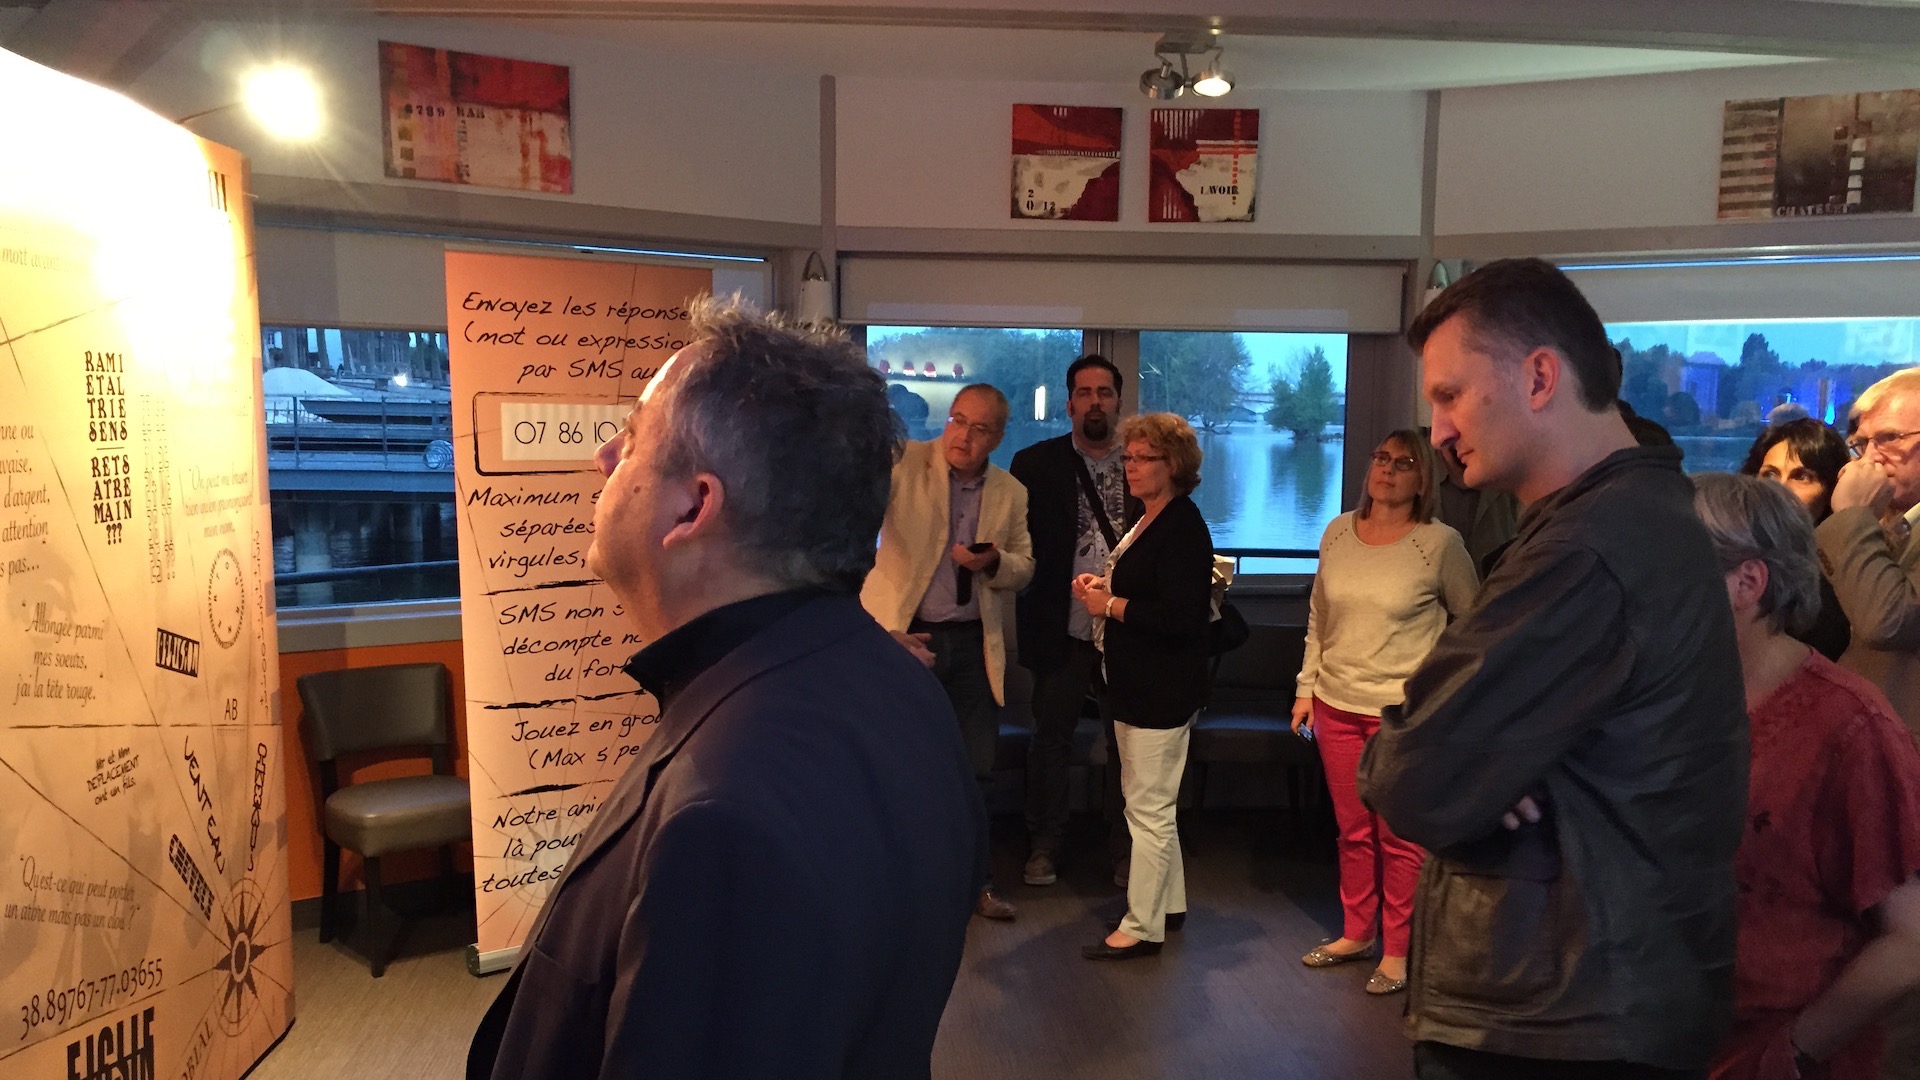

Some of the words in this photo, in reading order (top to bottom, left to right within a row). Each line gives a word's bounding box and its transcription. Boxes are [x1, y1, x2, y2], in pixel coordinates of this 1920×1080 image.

[1027, 188, 1035, 198] 2
[462, 291, 553, 321] Envoyez
[562, 296, 597, 316] les
[606, 301, 690, 325] réponse
[463, 320, 526, 344] (mot
[536, 333, 568, 348] ou
[84, 350, 124, 373] RAMI
[517, 364, 557, 384] par
[568, 358, 624, 380] SMS
[631, 367, 658, 381] au
[86, 374, 125, 396] ETAL
[87, 397, 127, 419] TRIE
[20, 424, 35, 440] ou
[89, 420, 128, 442] SENS
[514, 421, 547, 444] 07
[558, 421, 583, 444] 86
[594, 421, 618, 443] 10
[91, 454, 130, 478] RETS
[93, 476, 132, 502] ATRE
[468, 486, 580, 507] Maximum
[93, 498, 133, 525] MAIN
[2, 514, 50, 543] attention
[500, 517, 596, 543] séparées
[489, 546, 586, 578] virgules,
[499, 602, 557, 625] SMS
[565, 606, 604, 620] non
[74, 619, 105, 646] parmi
[503, 629, 612, 656] décompte
[33, 651, 53, 668] mes
[34, 665, 44, 698] la
[545, 664, 574, 682] du
[224, 698, 239, 721] AB
[511, 720, 580, 742] Jouez
[589, 719, 613, 732] en
[528, 748, 586, 770] (Max
[492, 805, 557, 829] Notre
[503, 838, 524, 859] là
[529, 833, 583, 861] pou
[482, 864, 564, 892] toutes
[86, 879, 108, 903] peut
[4, 903, 18, 920] un
[20, 888, 47, 923] arbre
[48, 902, 72, 926] mais
[72, 911, 92, 933] pas
[93, 913, 106, 929] un
[20, 957, 164, 1041] 38.89767-77.03655
